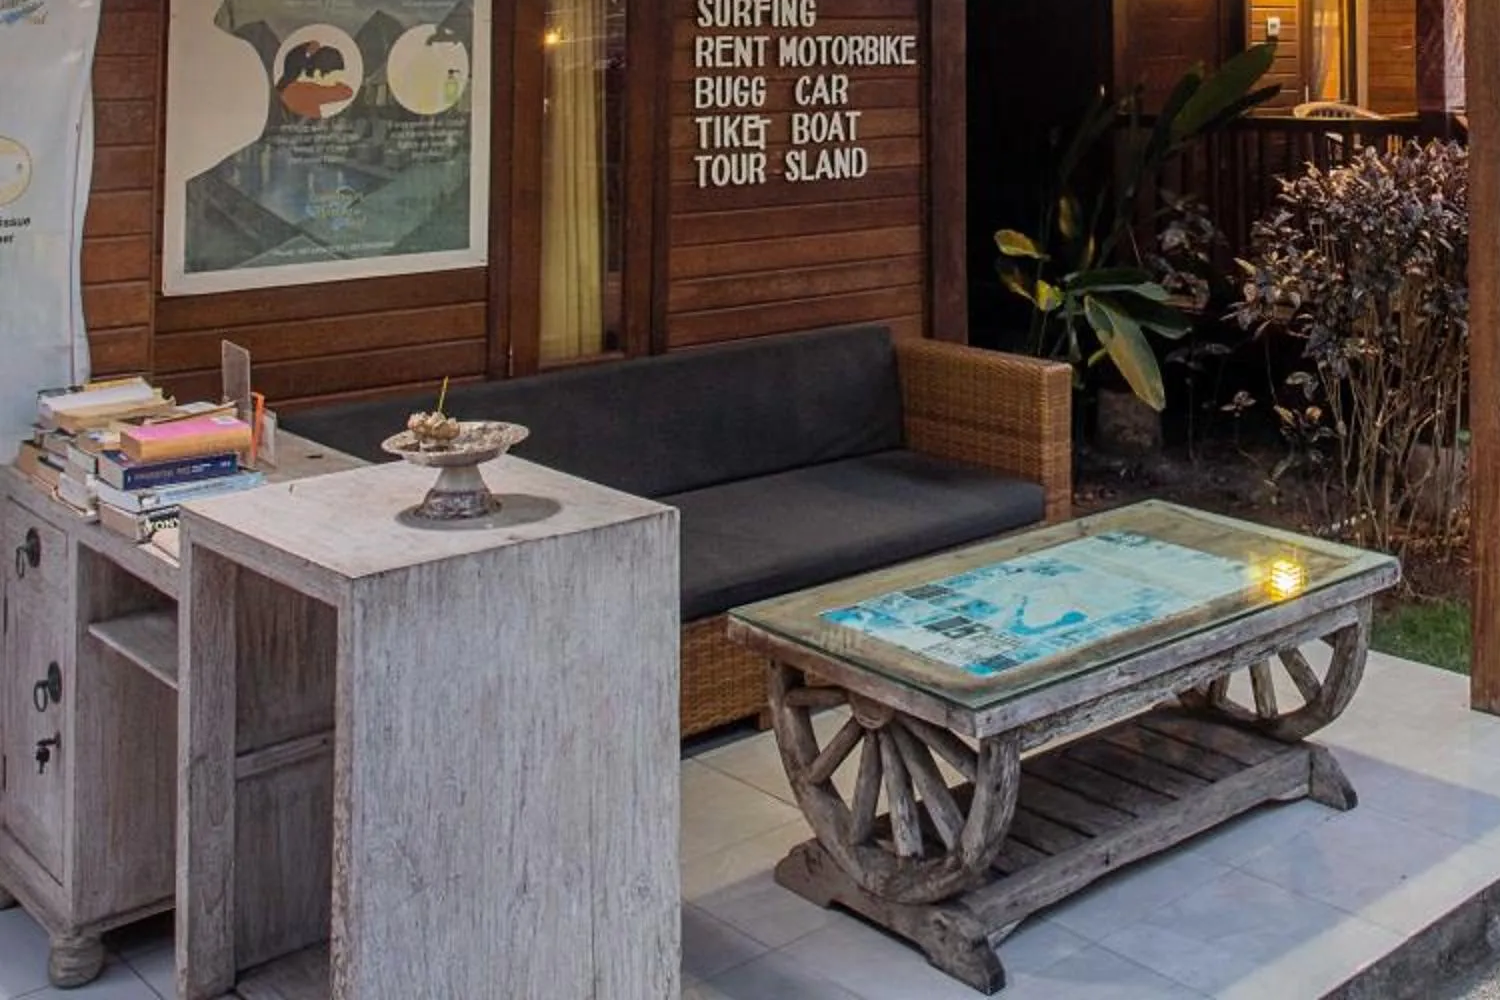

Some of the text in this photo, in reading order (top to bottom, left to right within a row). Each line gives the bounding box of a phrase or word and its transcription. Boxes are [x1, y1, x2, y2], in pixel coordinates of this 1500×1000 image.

[695, 35, 916, 68] RENT MOTORBIKE
[695, 74, 848, 109] BUGG CAR
[695, 111, 862, 150] TIKET BOAT
[694, 147, 868, 188] TOUR SLAND
